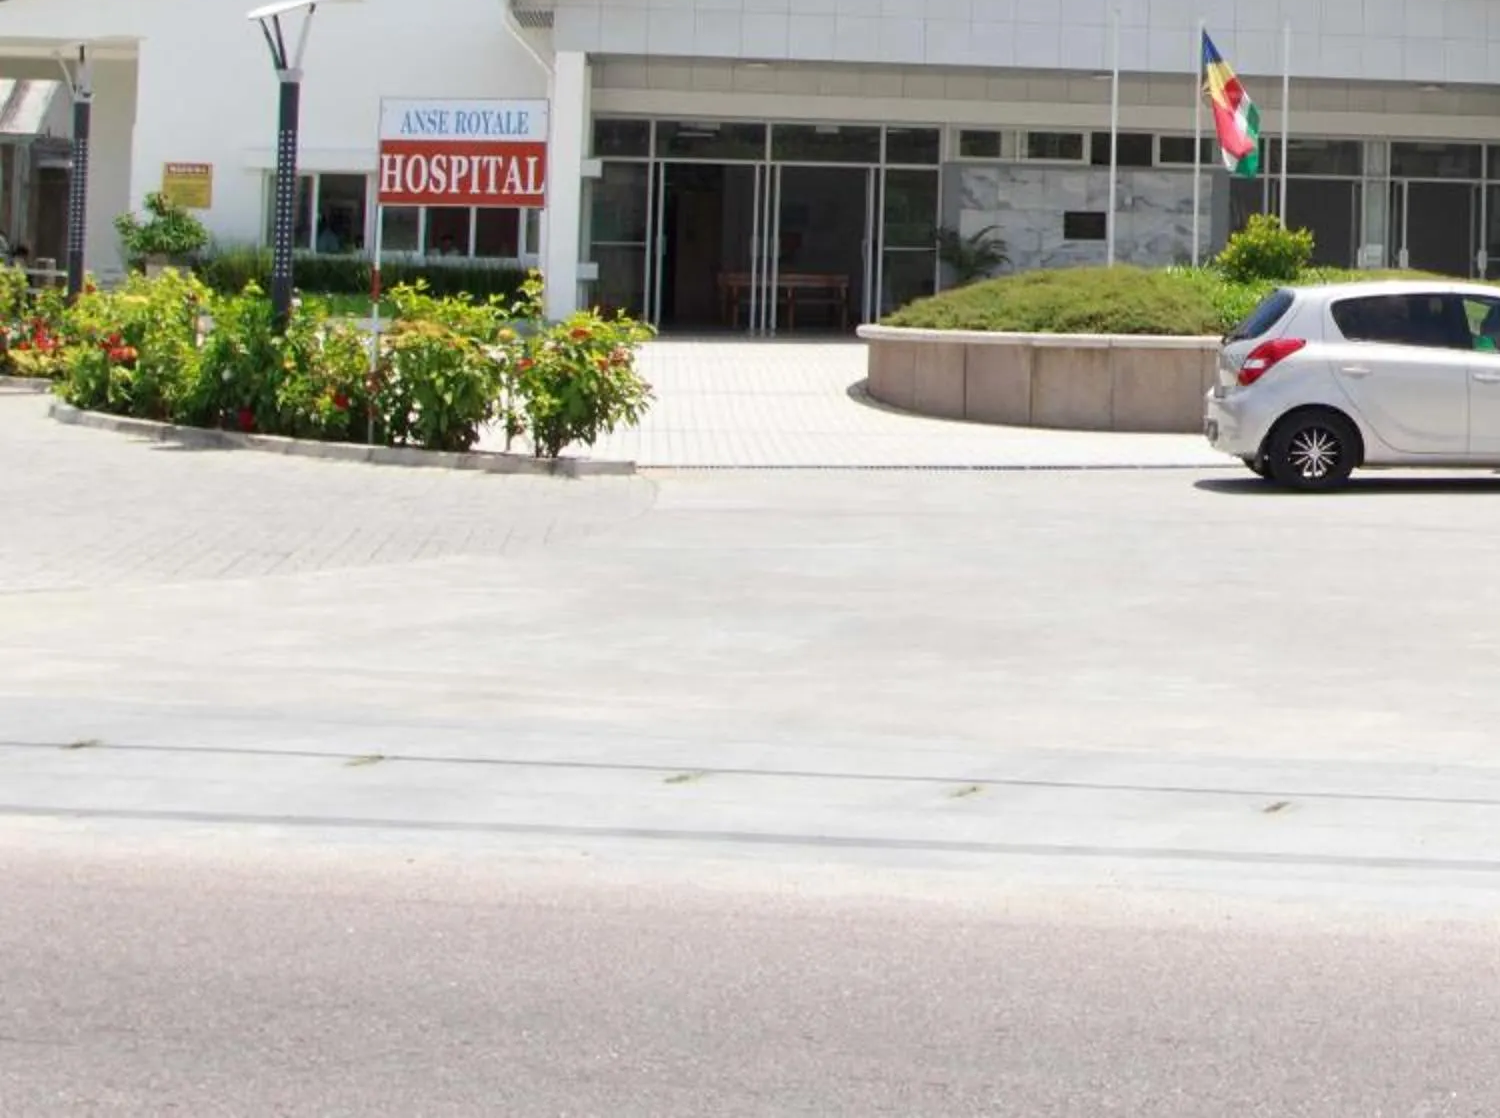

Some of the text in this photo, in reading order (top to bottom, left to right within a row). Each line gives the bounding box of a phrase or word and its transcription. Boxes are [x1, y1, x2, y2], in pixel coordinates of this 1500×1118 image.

[400, 110, 529, 135] ANSE ROYALE
[379, 153, 545, 195] HOSPITAL
